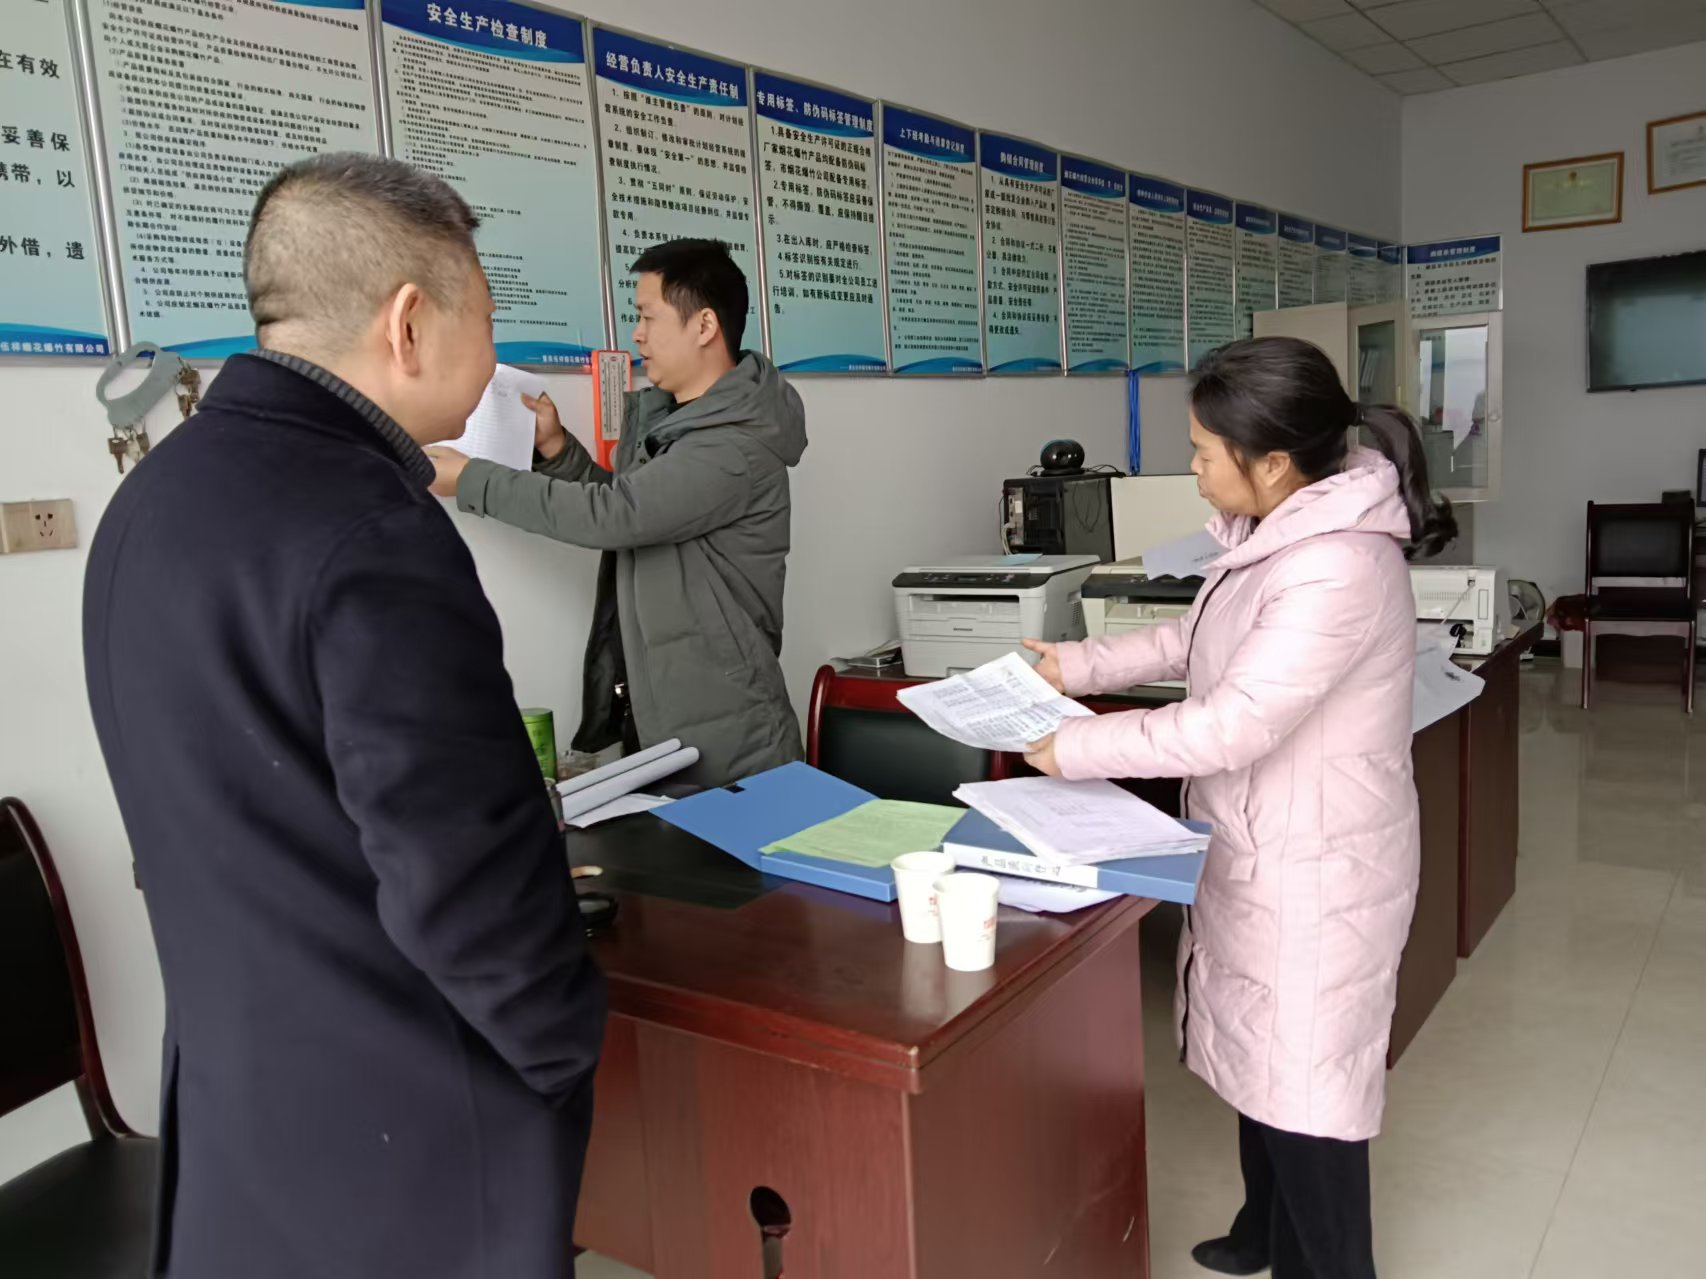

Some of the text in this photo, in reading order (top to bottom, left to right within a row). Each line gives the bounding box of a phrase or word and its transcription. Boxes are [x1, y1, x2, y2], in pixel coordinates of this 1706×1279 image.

[427, 3, 548, 49] 安全生产检查制度
[606, 52, 739, 100] 经营负责人安全生产责任制
[756, 90, 874, 132] 专用标签、防伪码标签管理制度
[1, 125, 71, 153] 妥善保
